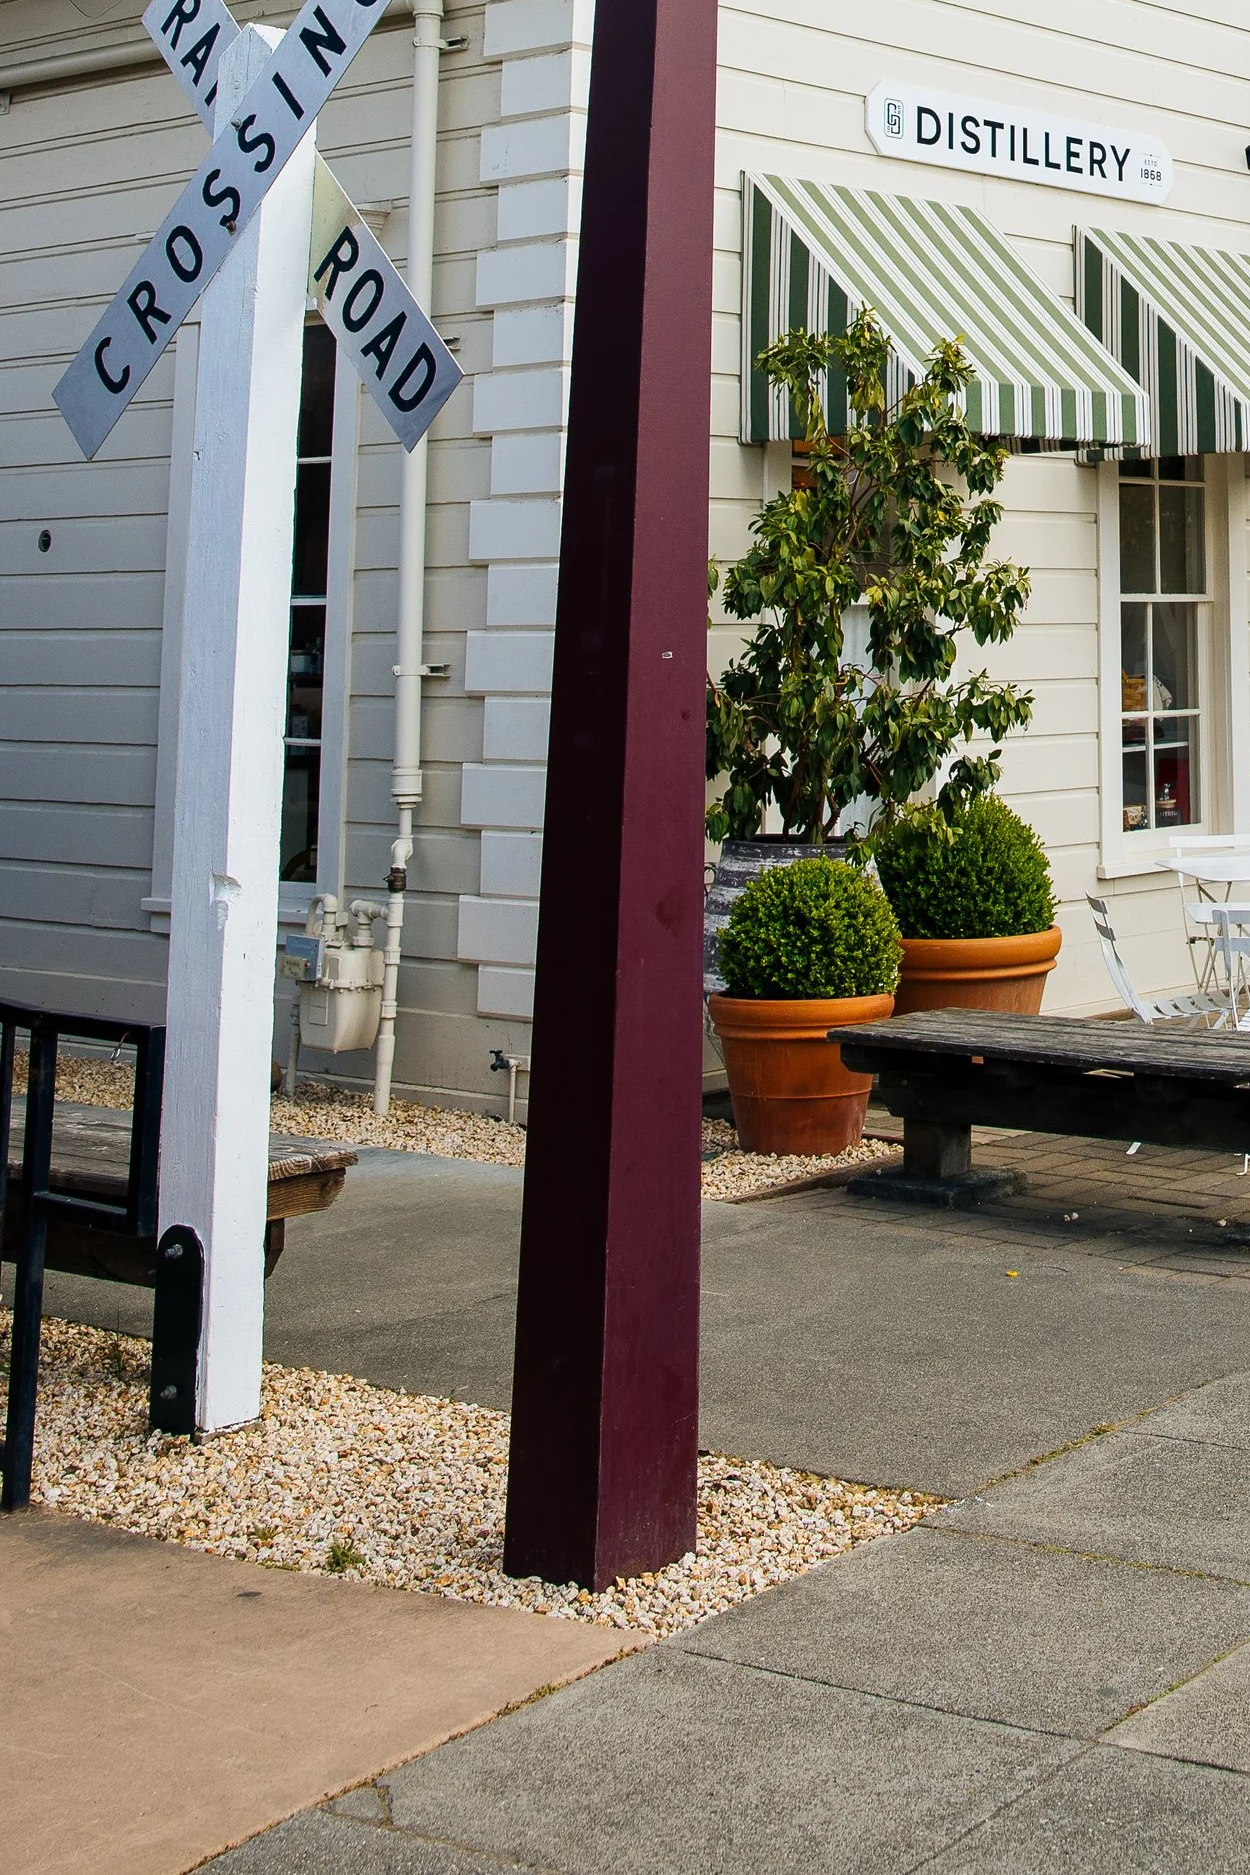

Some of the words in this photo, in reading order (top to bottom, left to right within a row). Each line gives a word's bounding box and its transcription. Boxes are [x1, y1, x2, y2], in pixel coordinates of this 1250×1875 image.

[915, 105, 1131, 183] DISTILLERY
[1139, 167, 1162, 182] 1868
[312, 225, 438, 414] ROAD
